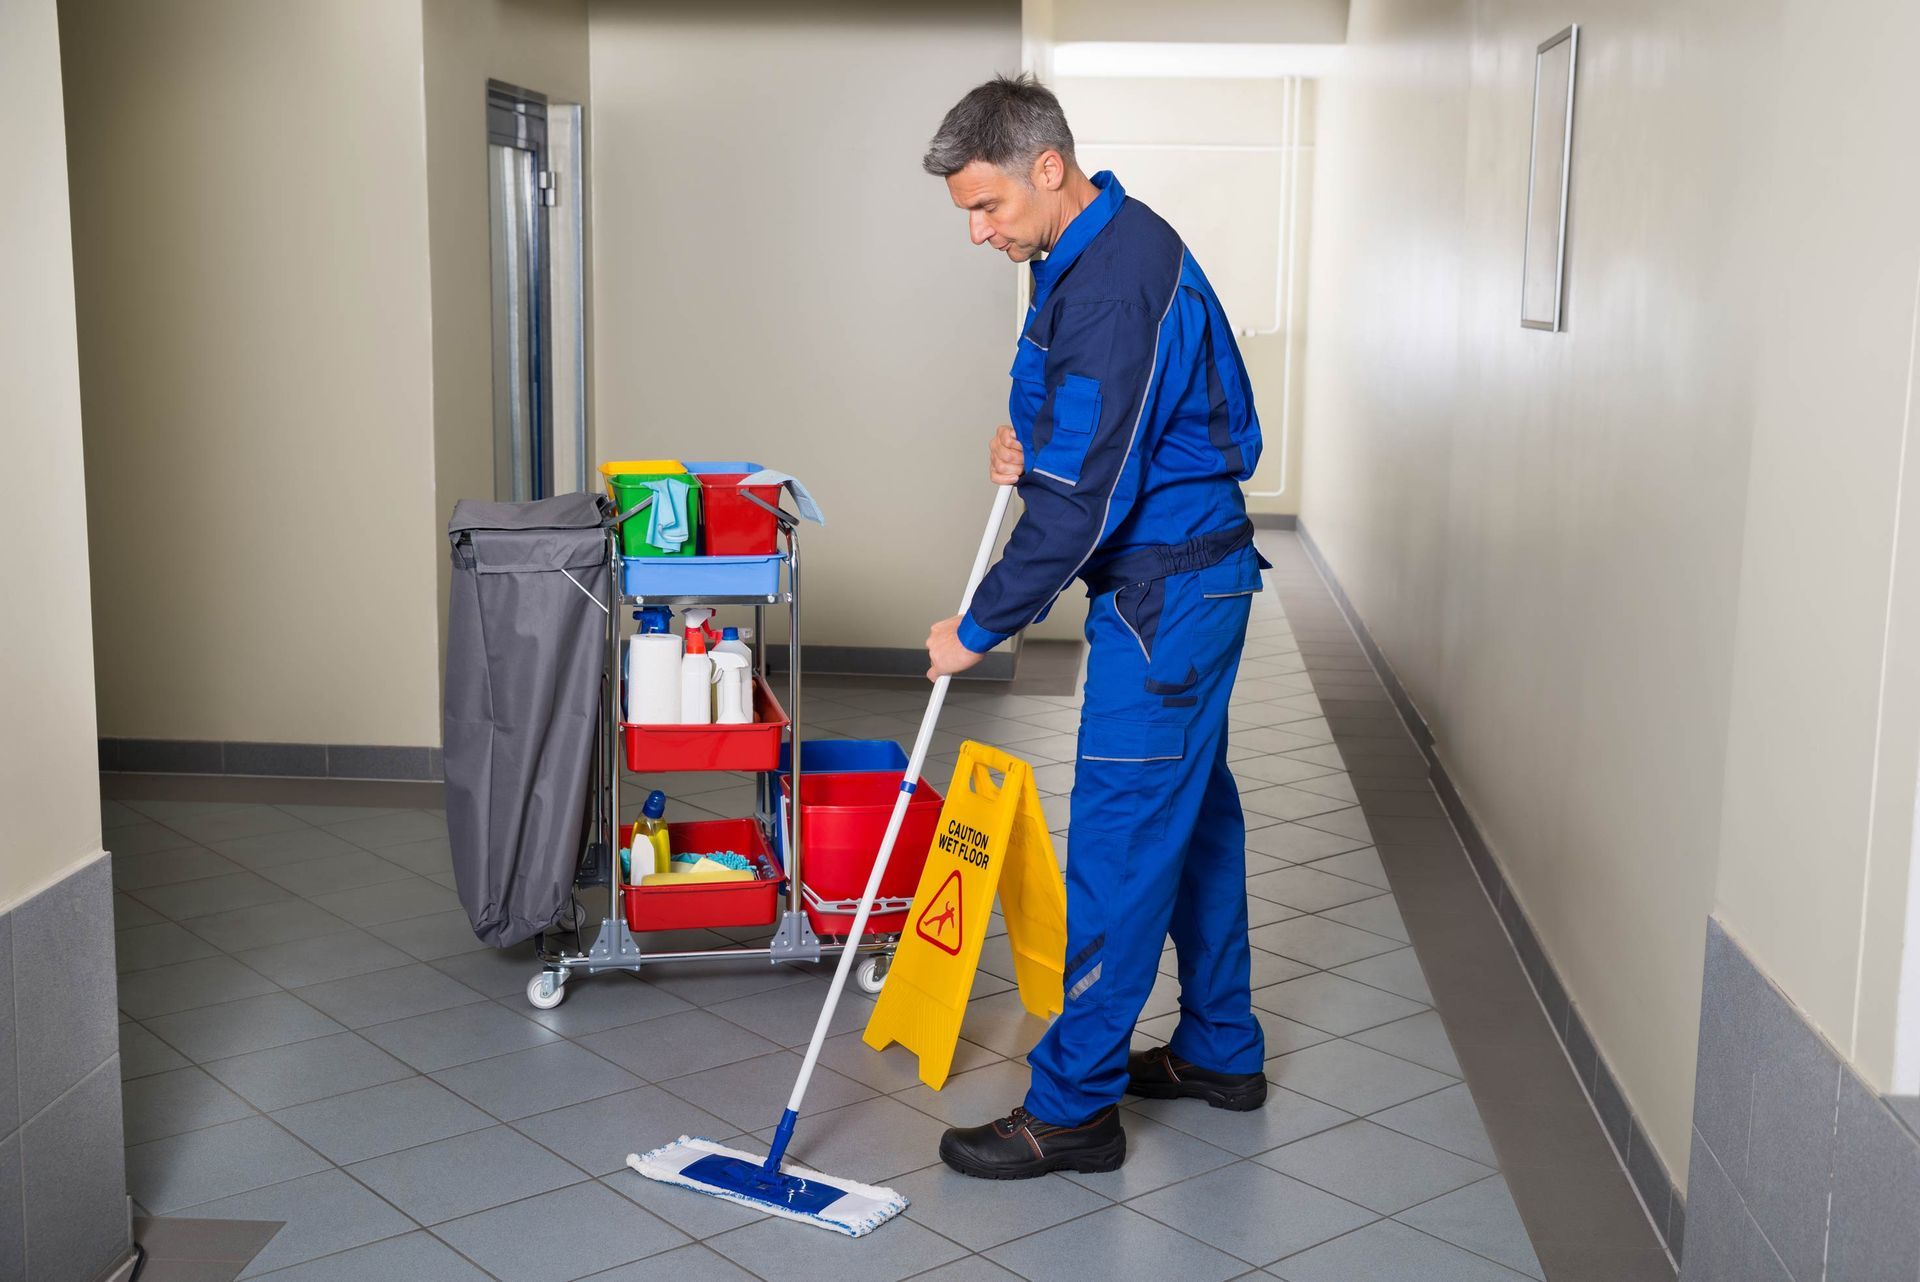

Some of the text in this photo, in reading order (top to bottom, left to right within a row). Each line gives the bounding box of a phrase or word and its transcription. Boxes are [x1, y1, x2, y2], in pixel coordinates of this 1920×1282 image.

[938, 833, 990, 870] WET FLOOR
[948, 819, 989, 850] CAUTION
